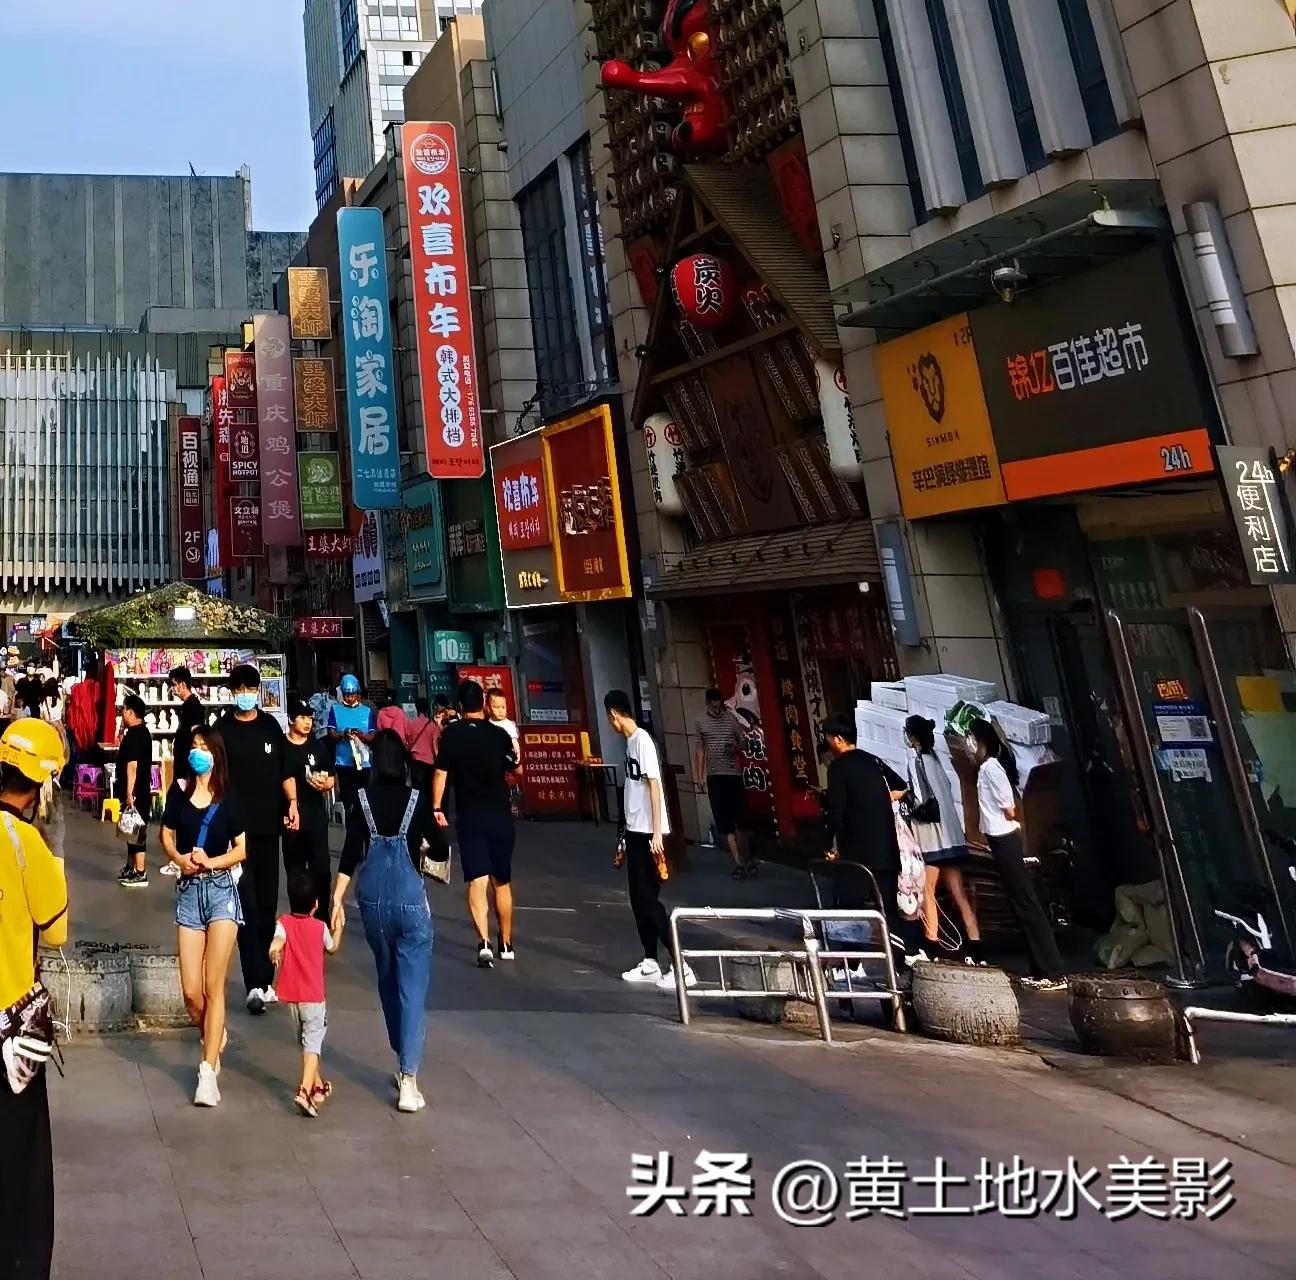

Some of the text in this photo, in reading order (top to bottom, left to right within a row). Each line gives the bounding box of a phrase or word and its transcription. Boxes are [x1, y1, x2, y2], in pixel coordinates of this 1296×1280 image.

[417, 183, 462, 340] 欢喜布车
[693, 256, 724, 316] 炭火
[349, 241, 390, 456] 乐淘家居
[1005, 321, 1151, 401] 锦亿百佳超市
[439, 347, 462, 445] 韩式大排档
[181, 432, 199, 488] 百视通
[232, 460, 258, 469] SPICY
[259, 373, 295, 521] 重庆鸡公煲
[1160, 444, 1192, 473] 24h
[1235, 460, 1275, 483] 24h
[185, 532, 201, 543] 2F
[1237, 485, 1279, 574] 便利店
